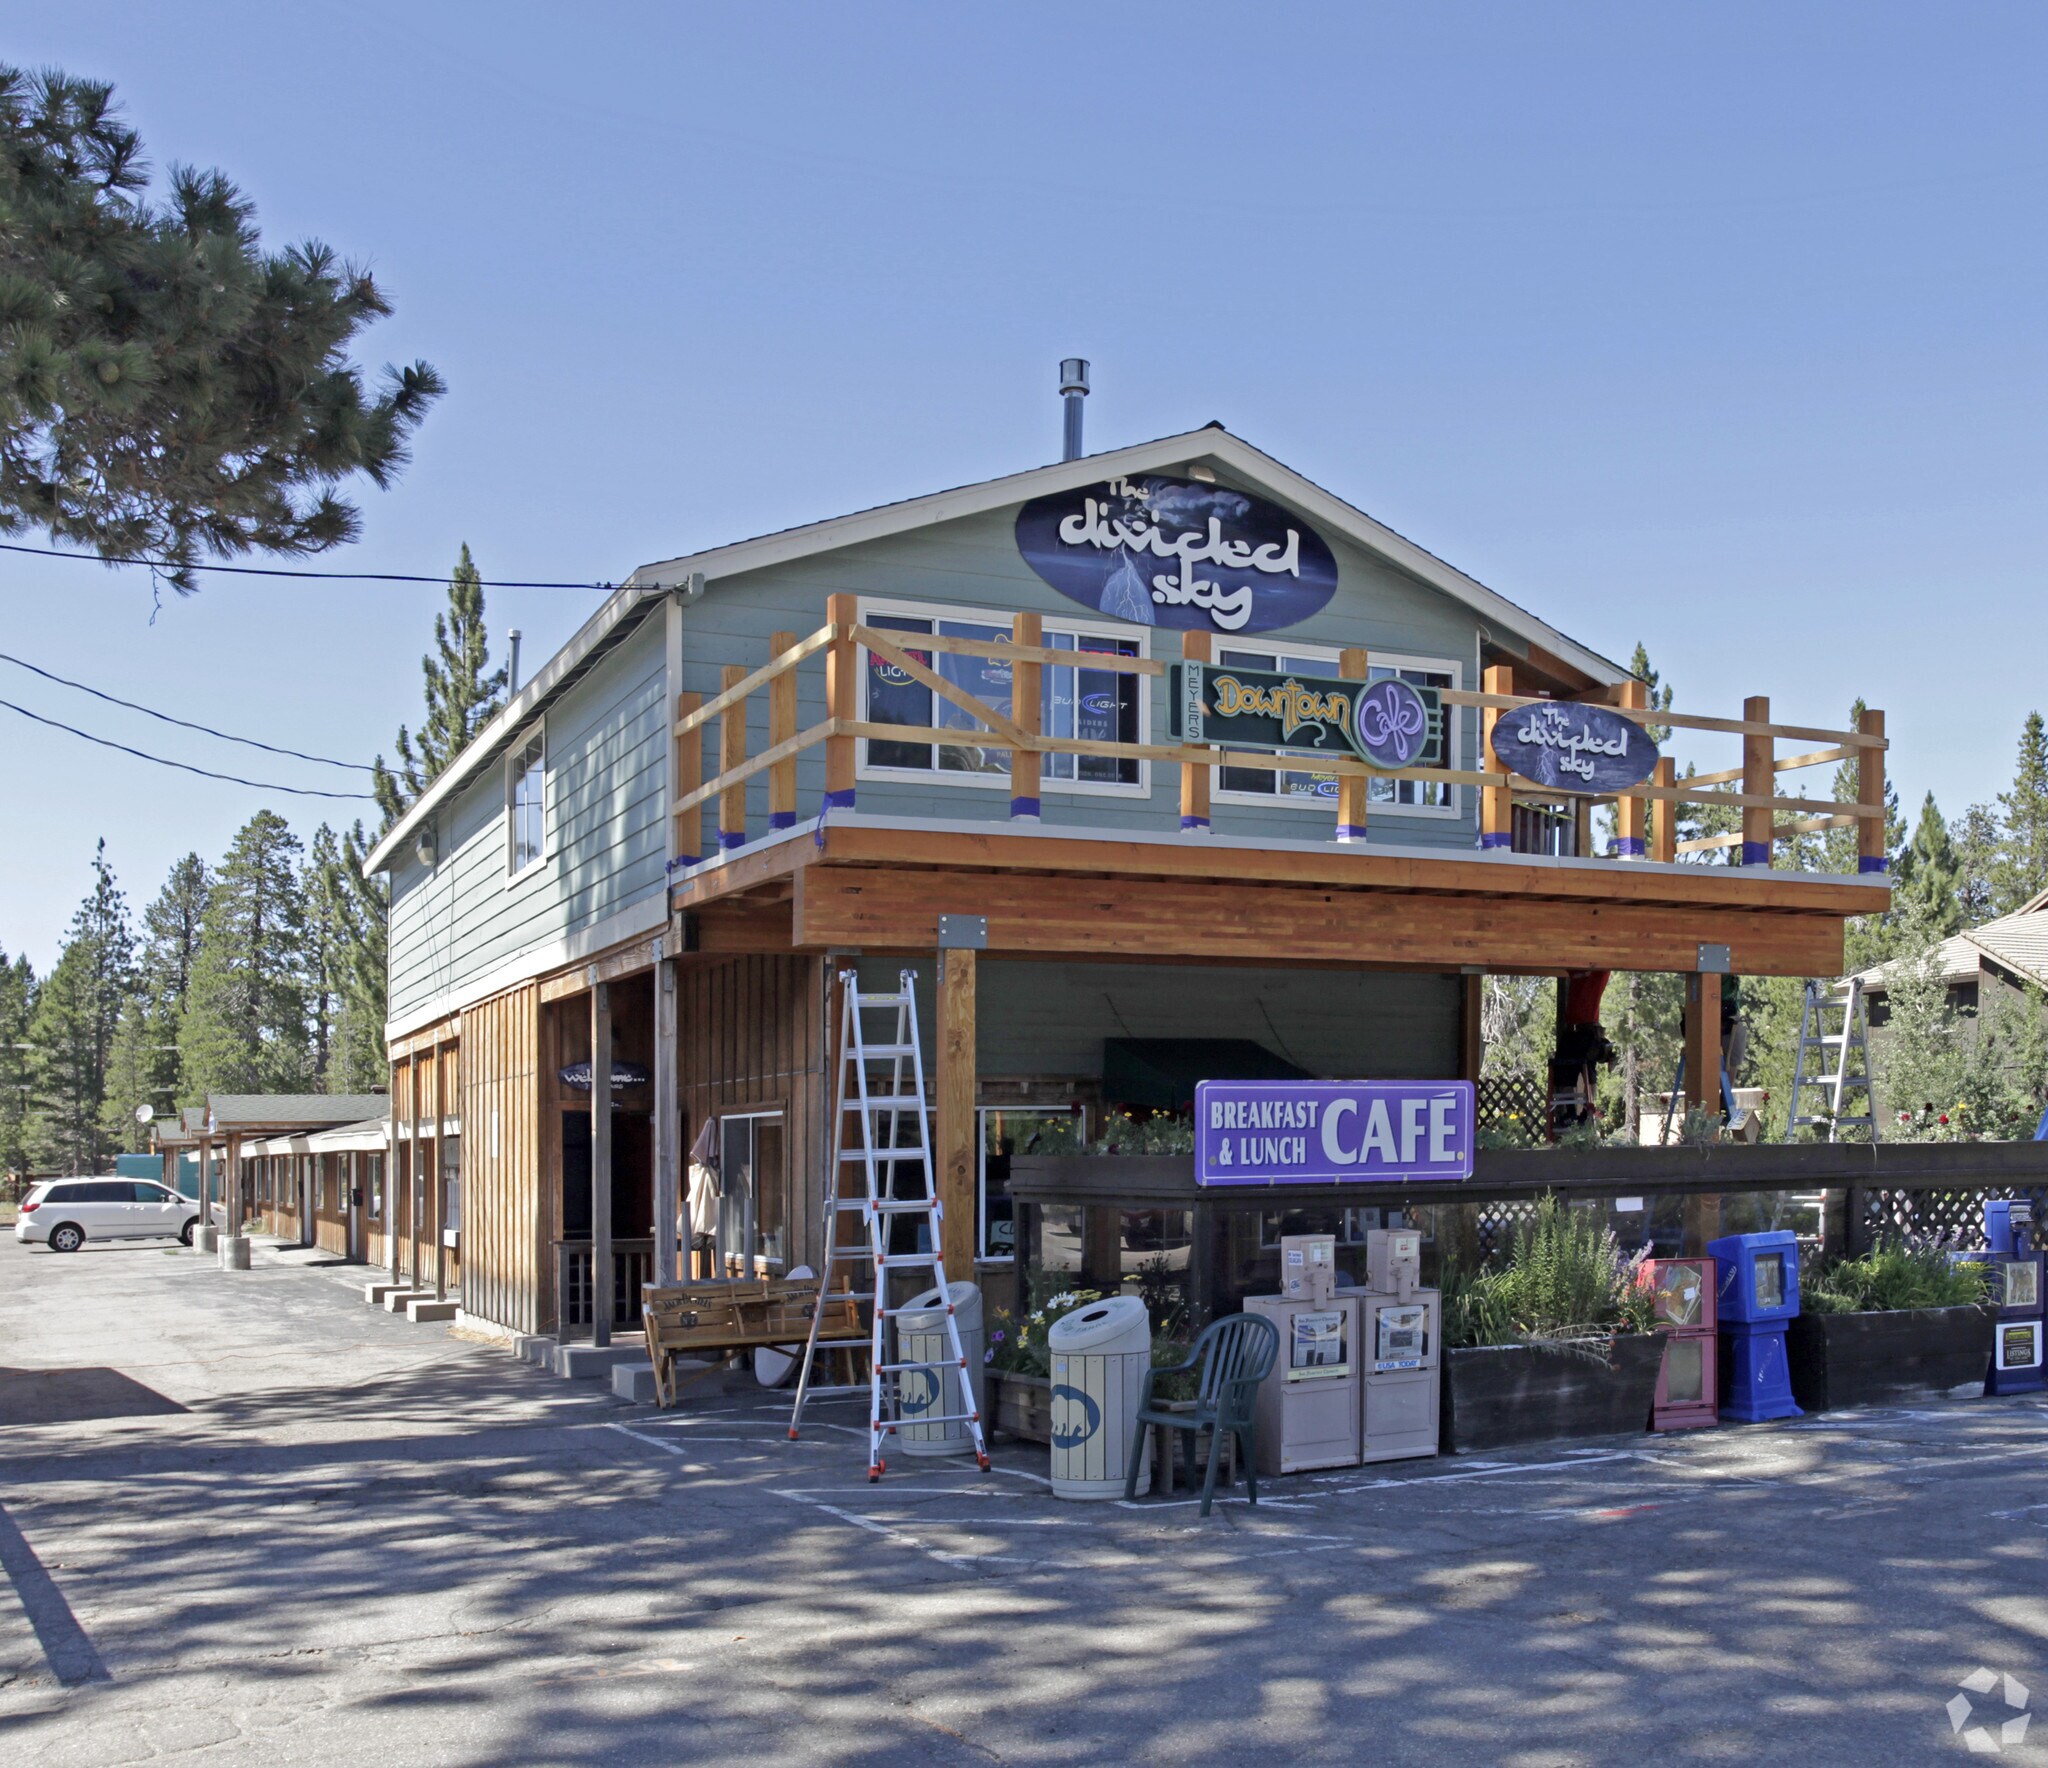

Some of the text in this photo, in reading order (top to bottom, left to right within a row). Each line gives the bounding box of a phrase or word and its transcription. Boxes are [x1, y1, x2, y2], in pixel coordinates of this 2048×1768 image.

[1105, 476, 1150, 499] The
[1059, 498, 1299, 577] divided
[1152, 554, 1252, 630] sky
[1187, 664, 1200, 739] MEYERS
[1213, 675, 1352, 743] Downtown
[1542, 708, 1570, 727] The
[1517, 714, 1628, 757] divided
[1560, 744, 1594, 781] sky
[1291, 783, 1316, 791] BUD
[1211, 1101, 1318, 1129] BREAKFAST
[1321, 1091, 1456, 1165] CAFÉ
[1219, 1137, 1306, 1166] & LUNCH
[1399, 1360, 1417, 1368] TODAY
